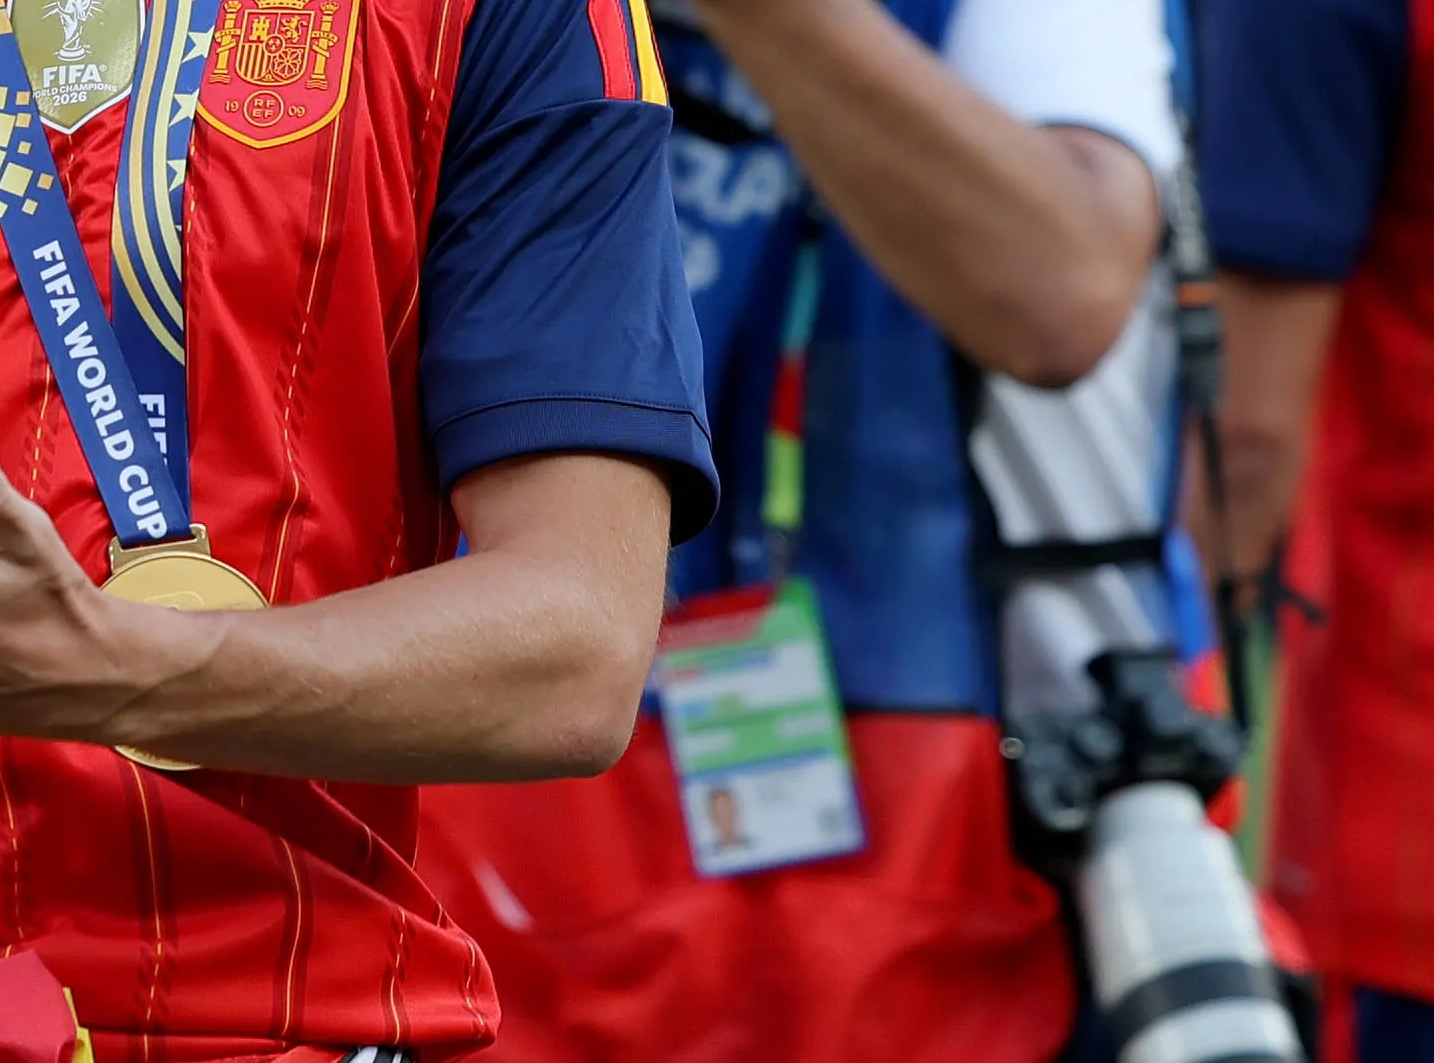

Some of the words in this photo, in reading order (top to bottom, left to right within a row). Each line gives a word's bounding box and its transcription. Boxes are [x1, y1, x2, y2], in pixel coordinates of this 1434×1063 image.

[59, 83, 117, 92] CHAMPIONS
[53, 92, 87, 106] 2026
[33, 240, 81, 325] FIFA
[64, 321, 134, 460] WORLD
[119, 465, 167, 538] CUP
